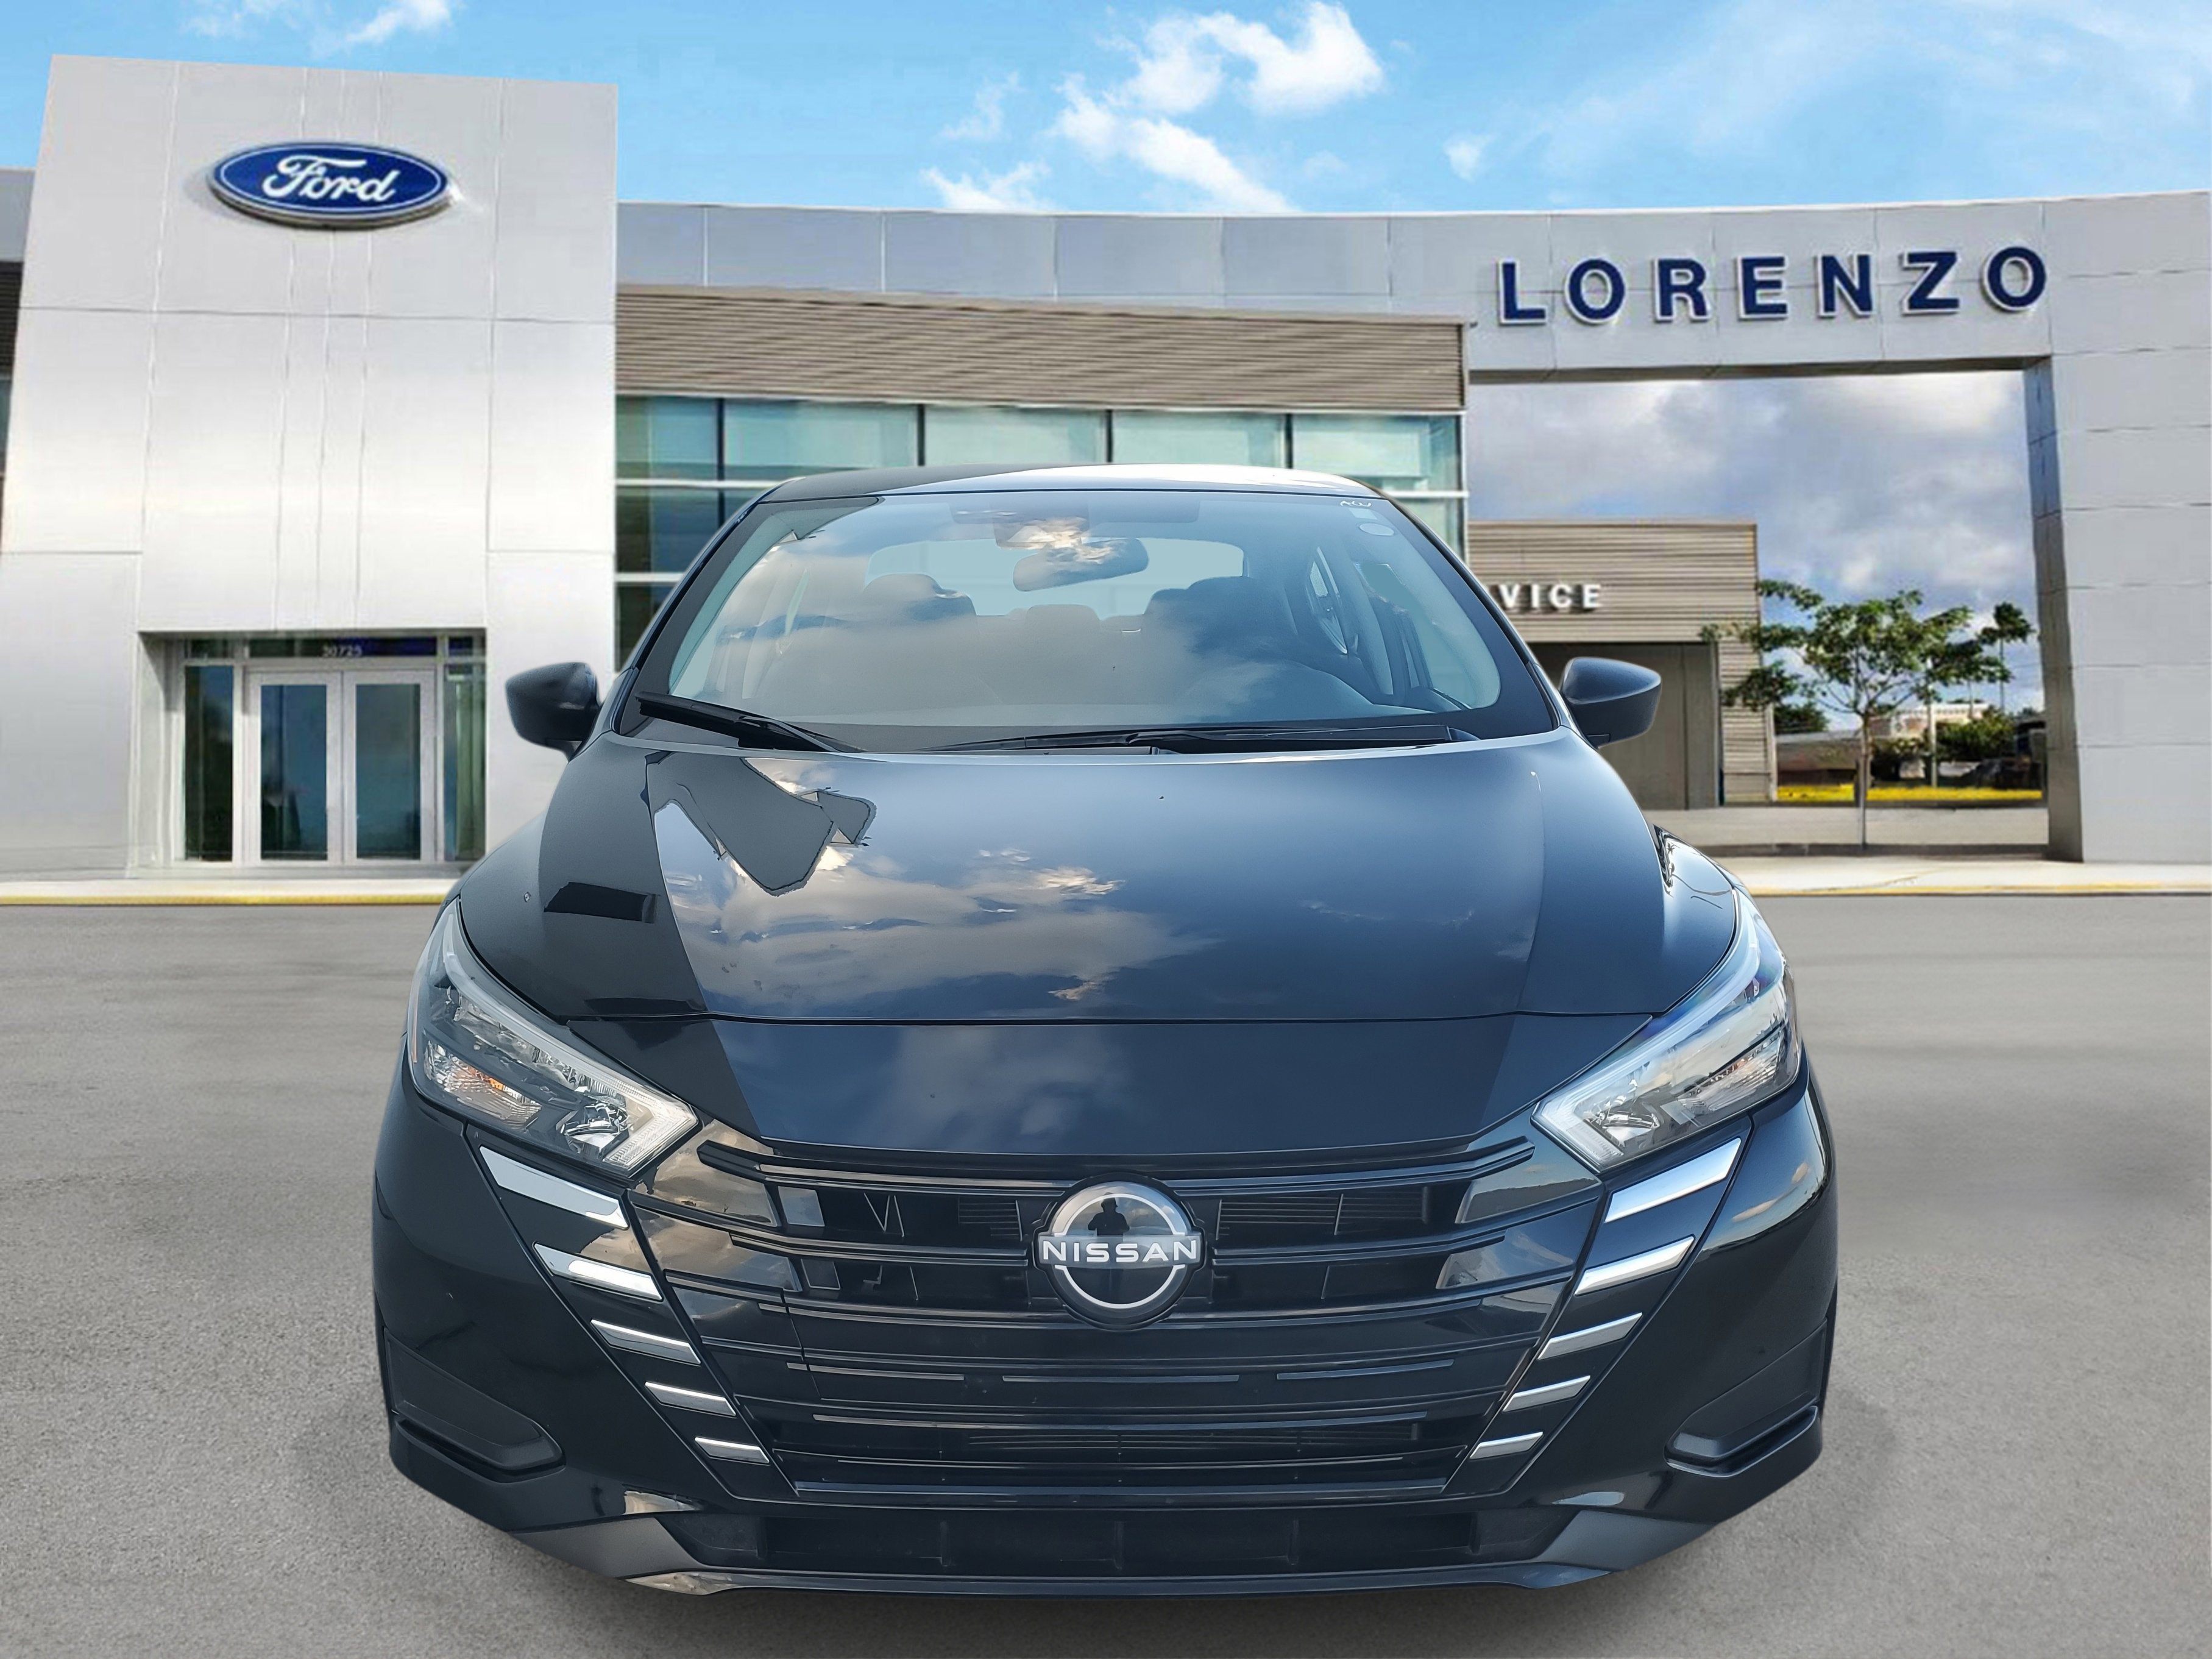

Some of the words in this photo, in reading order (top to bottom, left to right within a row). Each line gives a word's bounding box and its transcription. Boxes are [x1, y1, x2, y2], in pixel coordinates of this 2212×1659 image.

[261, 154, 401, 202] Ford
[1497, 244, 2047, 323] LORENZO
[1498, 583, 1603, 608] VICE
[1043, 1240, 1197, 1262] NISSAN
